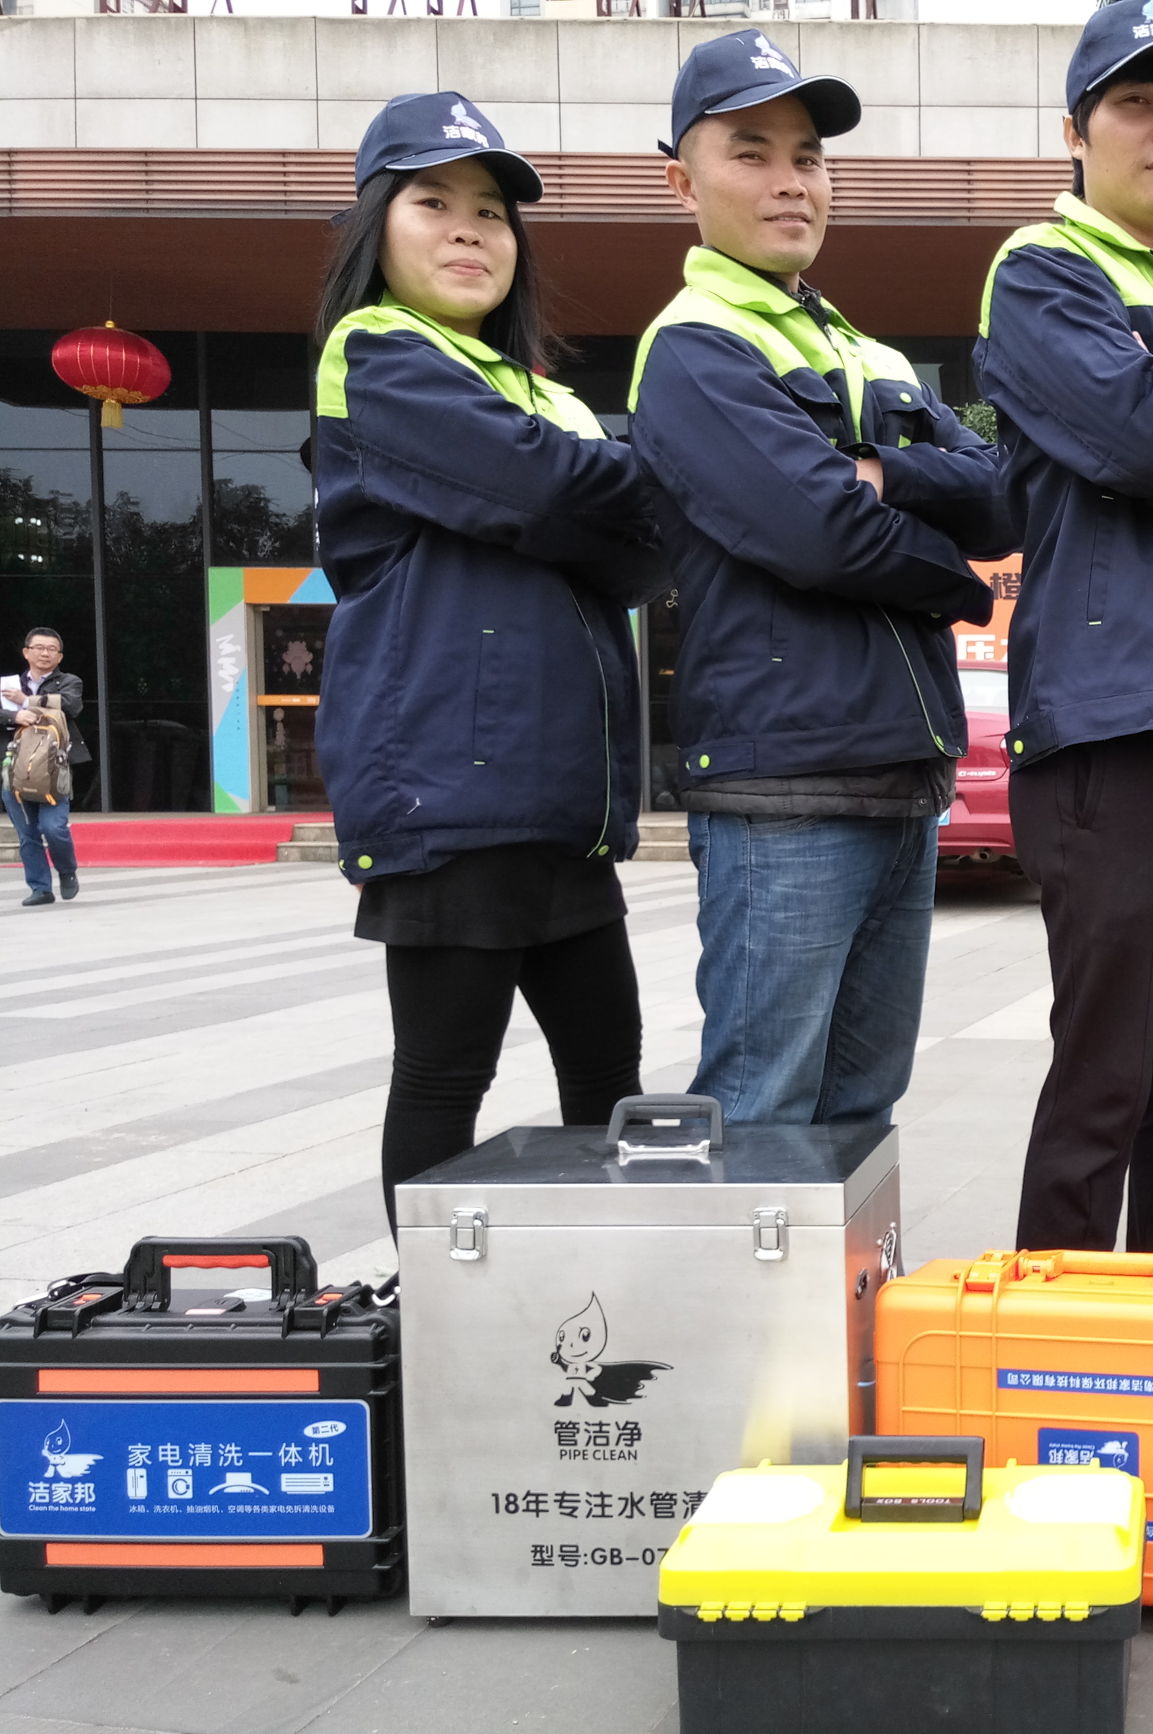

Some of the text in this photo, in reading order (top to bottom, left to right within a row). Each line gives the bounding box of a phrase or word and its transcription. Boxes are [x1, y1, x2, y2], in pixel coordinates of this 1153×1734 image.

[311, 1423, 339, 1435] 第二代
[554, 1420, 642, 1448] 管洁净
[127, 1442, 334, 1467] 家电清洗一体机
[560, 1449, 638, 1461] PIPE CLEAN
[28, 1481, 96, 1504] 洁家邦
[28, 1504, 48, 1512] Clean
